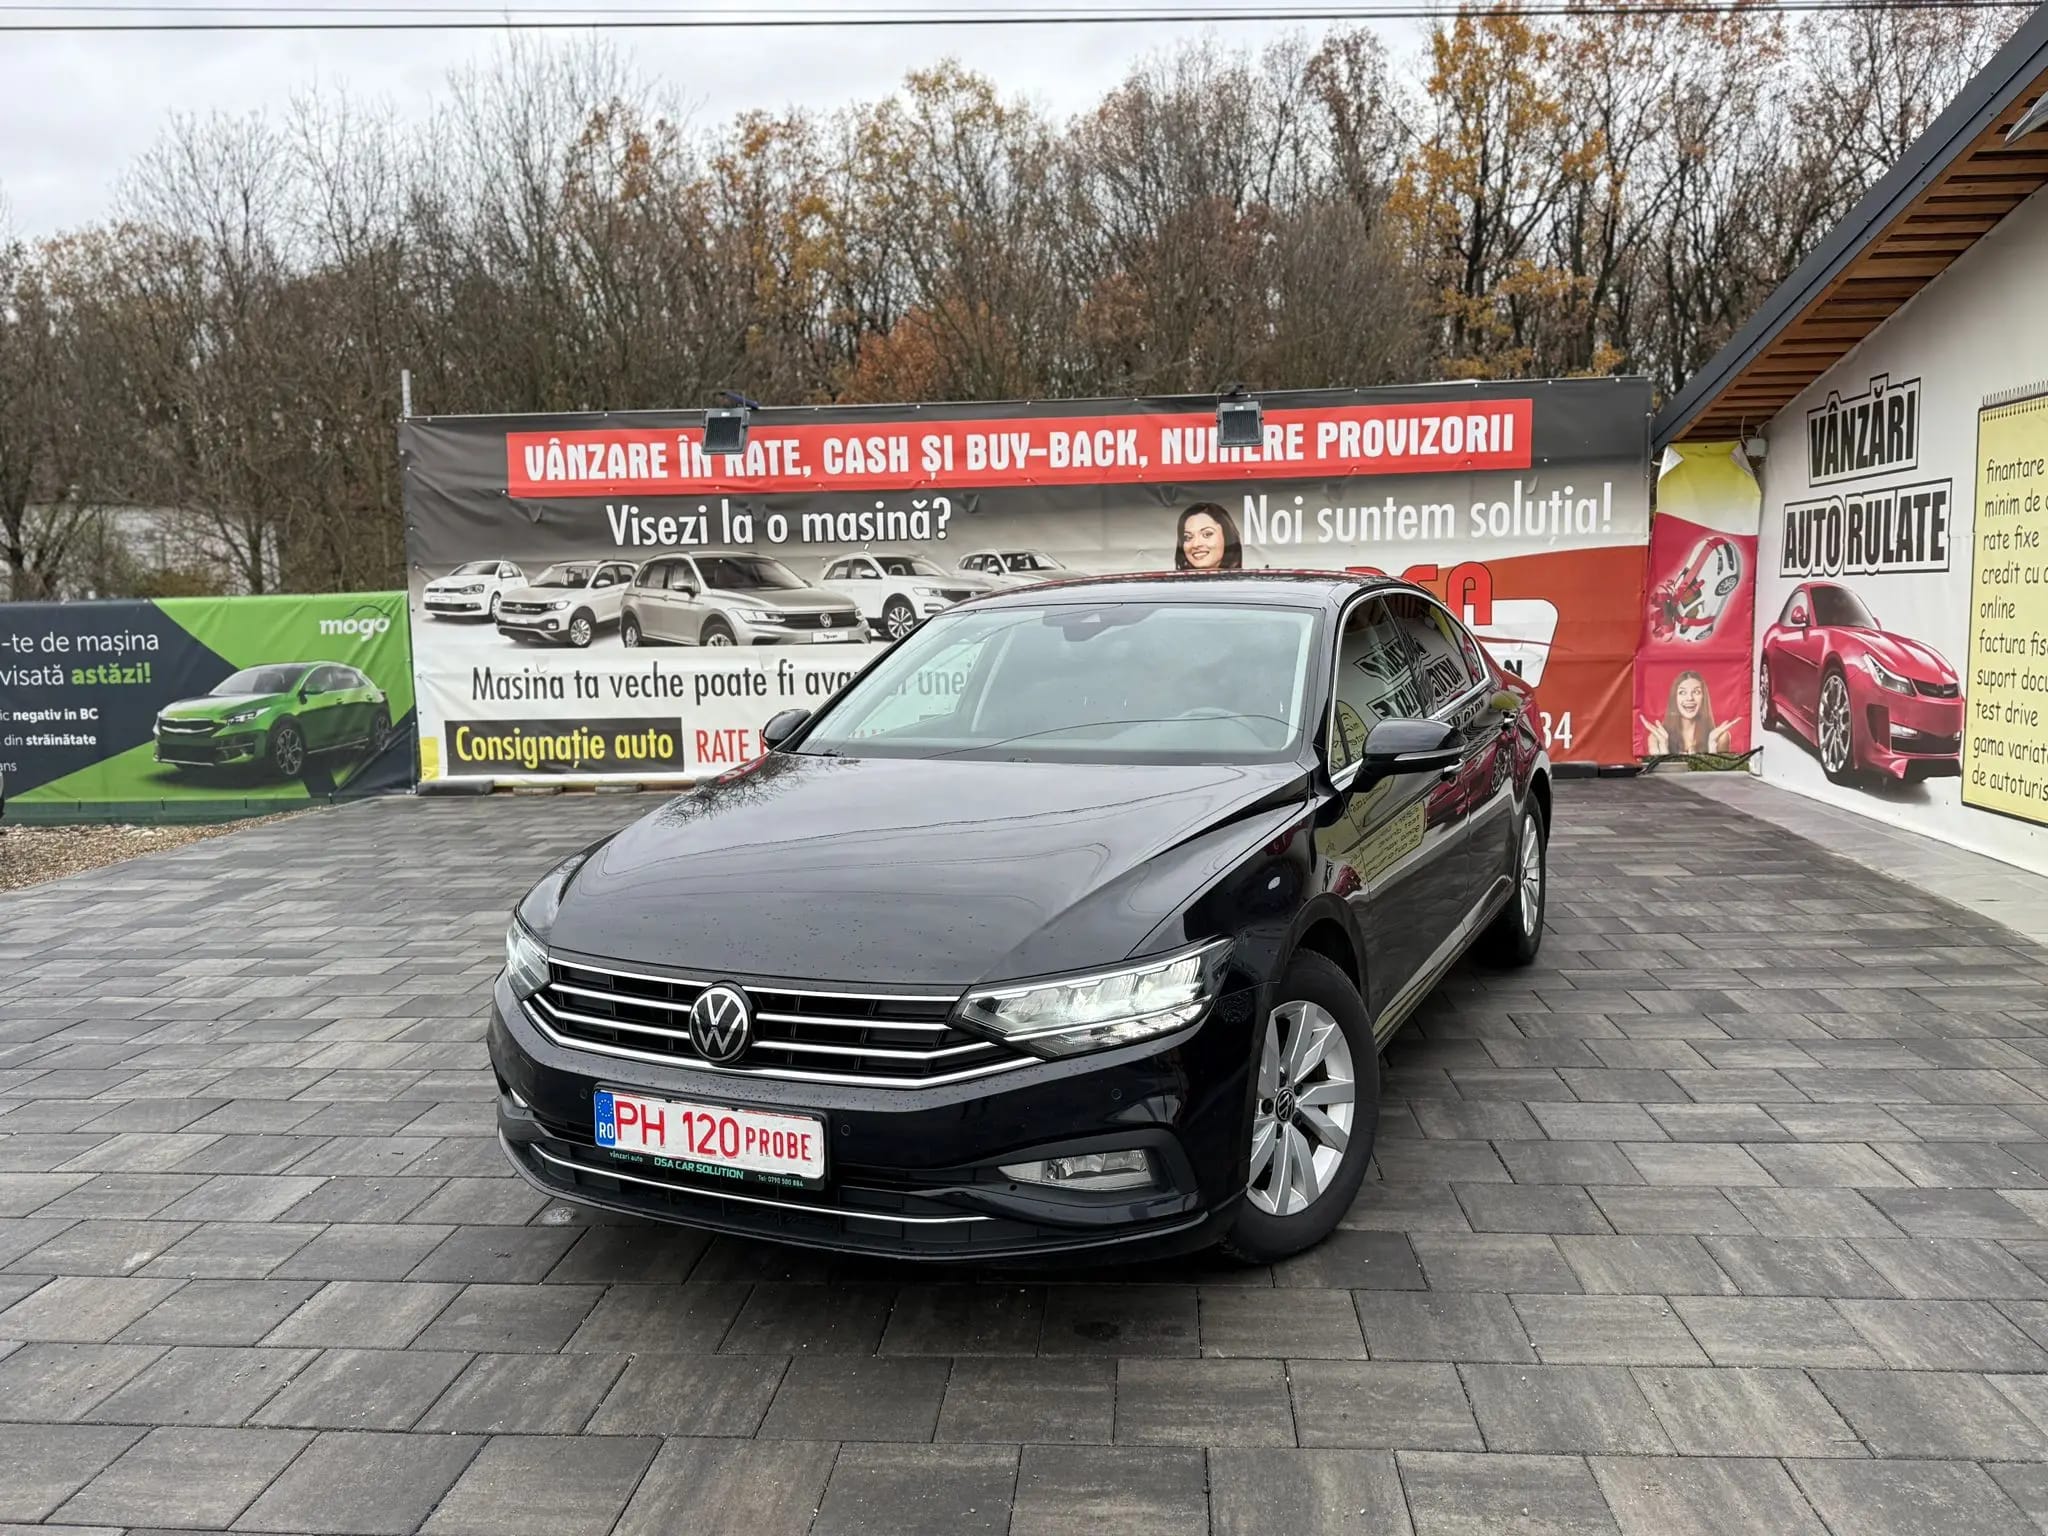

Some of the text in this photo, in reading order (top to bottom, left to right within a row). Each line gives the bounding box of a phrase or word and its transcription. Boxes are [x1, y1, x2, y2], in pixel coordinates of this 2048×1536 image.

[1810, 386, 1916, 478] VÂNZĂRI
[524, 437, 669, 481] VÂNZARE
[822, 433, 909, 474] CASH
[921, 434, 953, 480] ȘI
[965, 428, 1148, 472] BUY-BACK,
[1316, 413, 1515, 459] PROVIZORII
[1986, 457, 2045, 485] finantare
[1243, 480, 1612, 545] Noi suntem soluția!
[1984, 492, 2020, 518] minim
[2024, 487, 2041, 513] de
[606, 496, 952, 552] Visezi la o mașină?
[1783, 490, 1947, 569] AUTO RULATE
[1983, 524, 2040, 551] rate fixe
[1981, 559, 2021, 585] credit
[2024, 565, 2039, 585] cu
[1980, 593, 2016, 620] online
[40, 631, 70, 653] de
[76, 629, 160, 656] mașina
[320, 617, 391, 642] mogo
[1979, 629, 2026, 655] factura
[71, 661, 152, 685] astăzi!
[471, 666, 564, 701] Masina
[573, 670, 600, 699] ta
[609, 661, 684, 698] veche
[694, 667, 768, 705] poate
[776, 658, 795, 696] fi
[1976, 667, 2017, 694] suport
[13, 709, 61, 724] negativ
[64, 708, 77, 721] in
[80, 707, 99, 720] BC
[1976, 698, 2039, 728] test drive
[26, 733, 97, 746] străinătate
[455, 726, 673, 769] Consignație auto
[695, 729, 749, 763] RATE
[1973, 736, 2004, 759] gama
[1972, 763, 1986, 786] de
[599, 1122, 613, 1139] RO
[615, 1101, 812, 1160] PH 120 PROBE
[654, 1157, 744, 1180] DSA CAR SOLUTION
